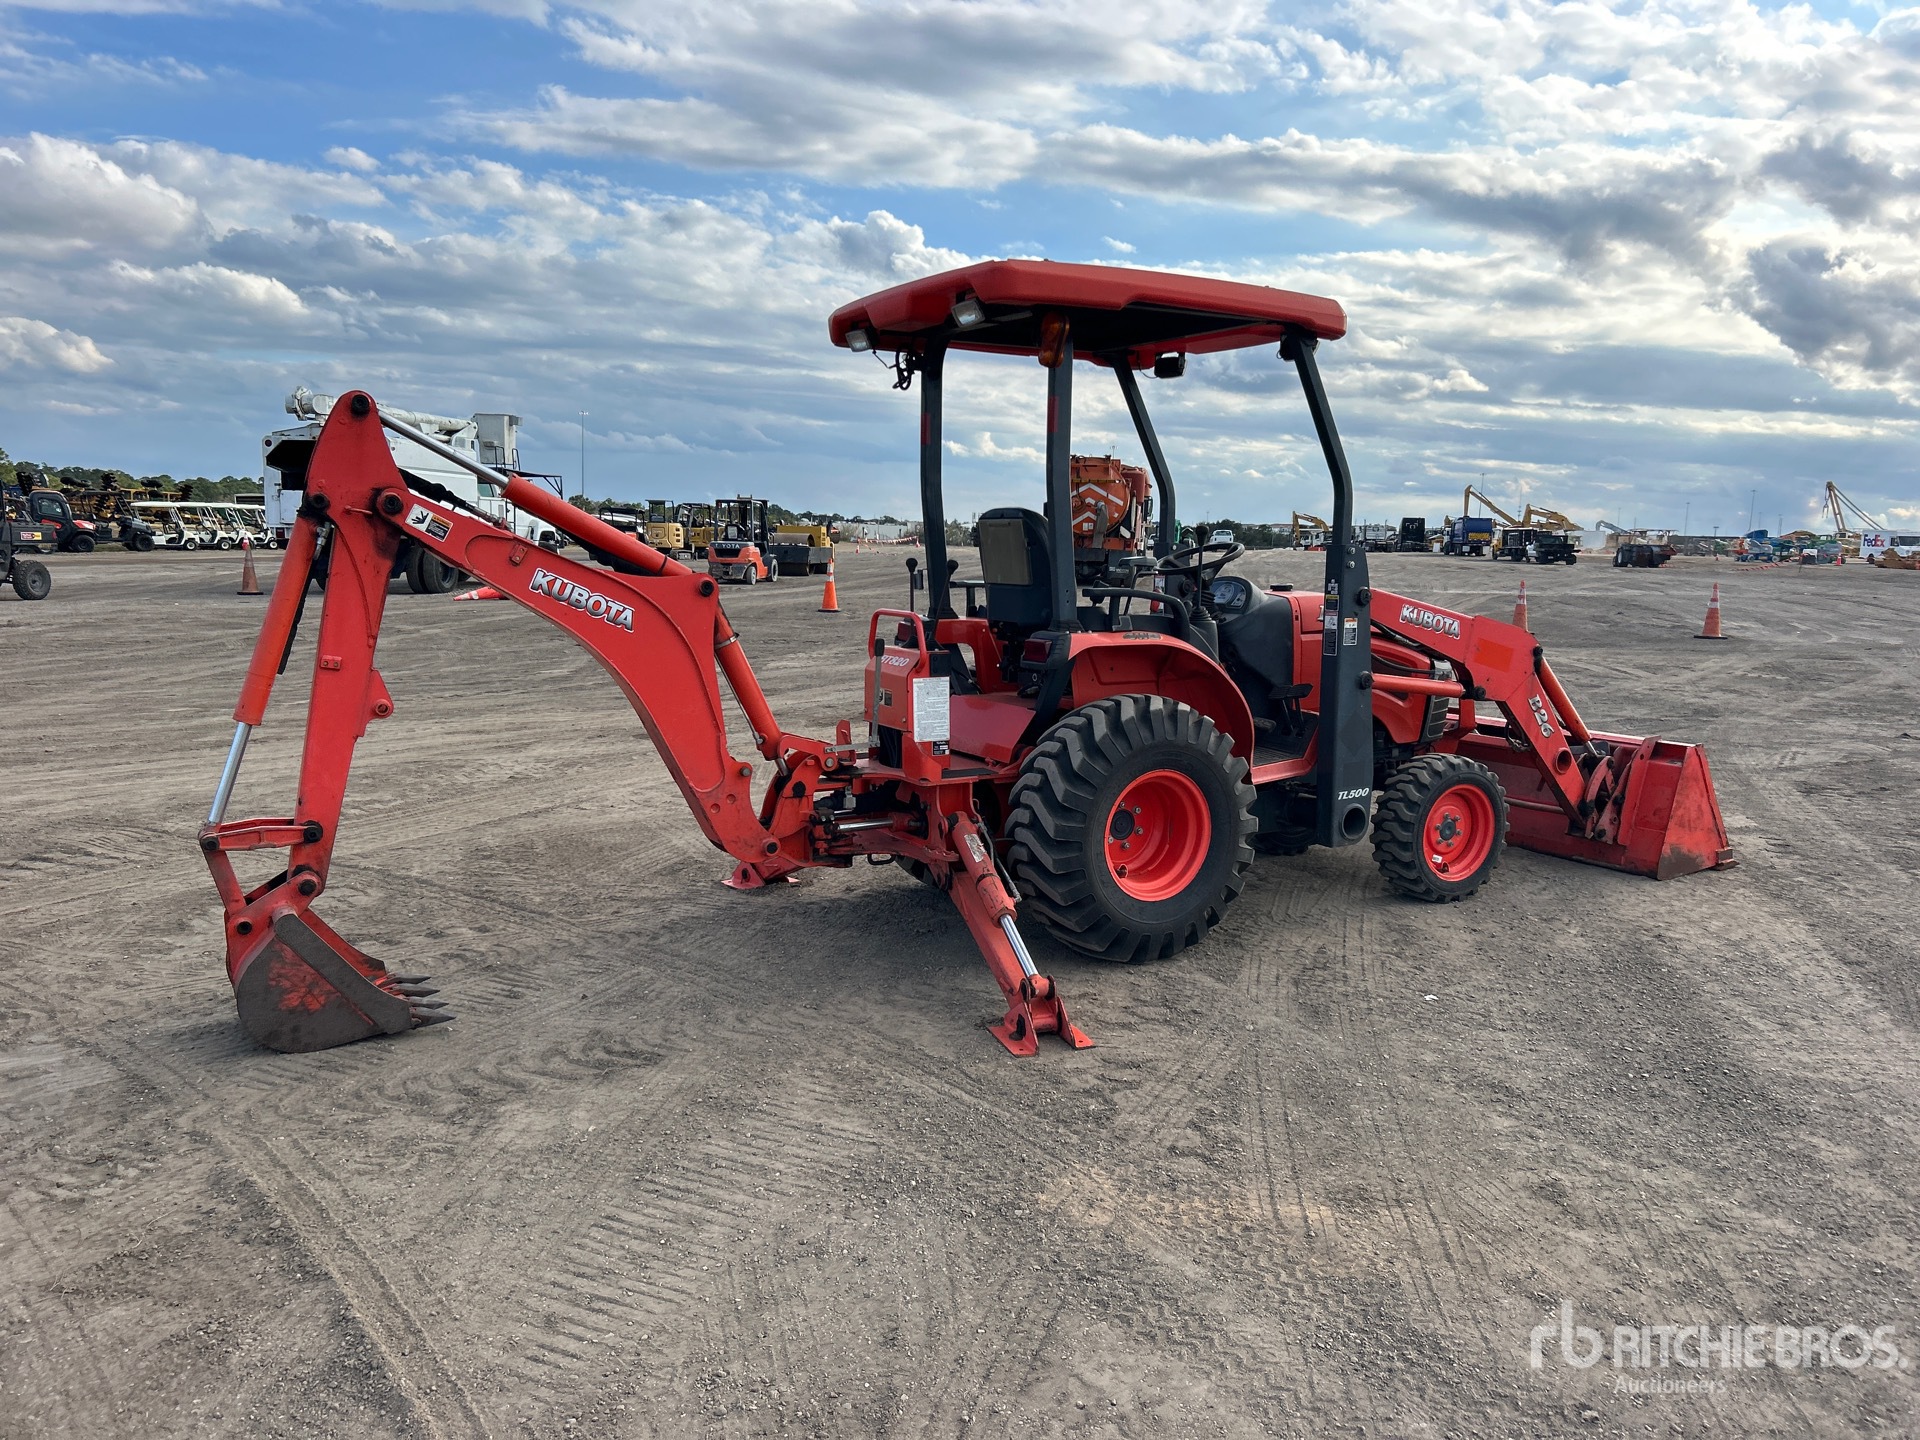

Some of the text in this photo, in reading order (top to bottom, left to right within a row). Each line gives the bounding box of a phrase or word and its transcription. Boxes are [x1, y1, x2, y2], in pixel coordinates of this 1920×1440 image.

[1863, 534, 1885, 547] FedEx
[530, 568, 635, 632] KUBOTA
[1400, 604, 1460, 639] KUBOTA
[1528, 694, 1555, 737] B26
[1338, 788, 1370, 800] TL500
